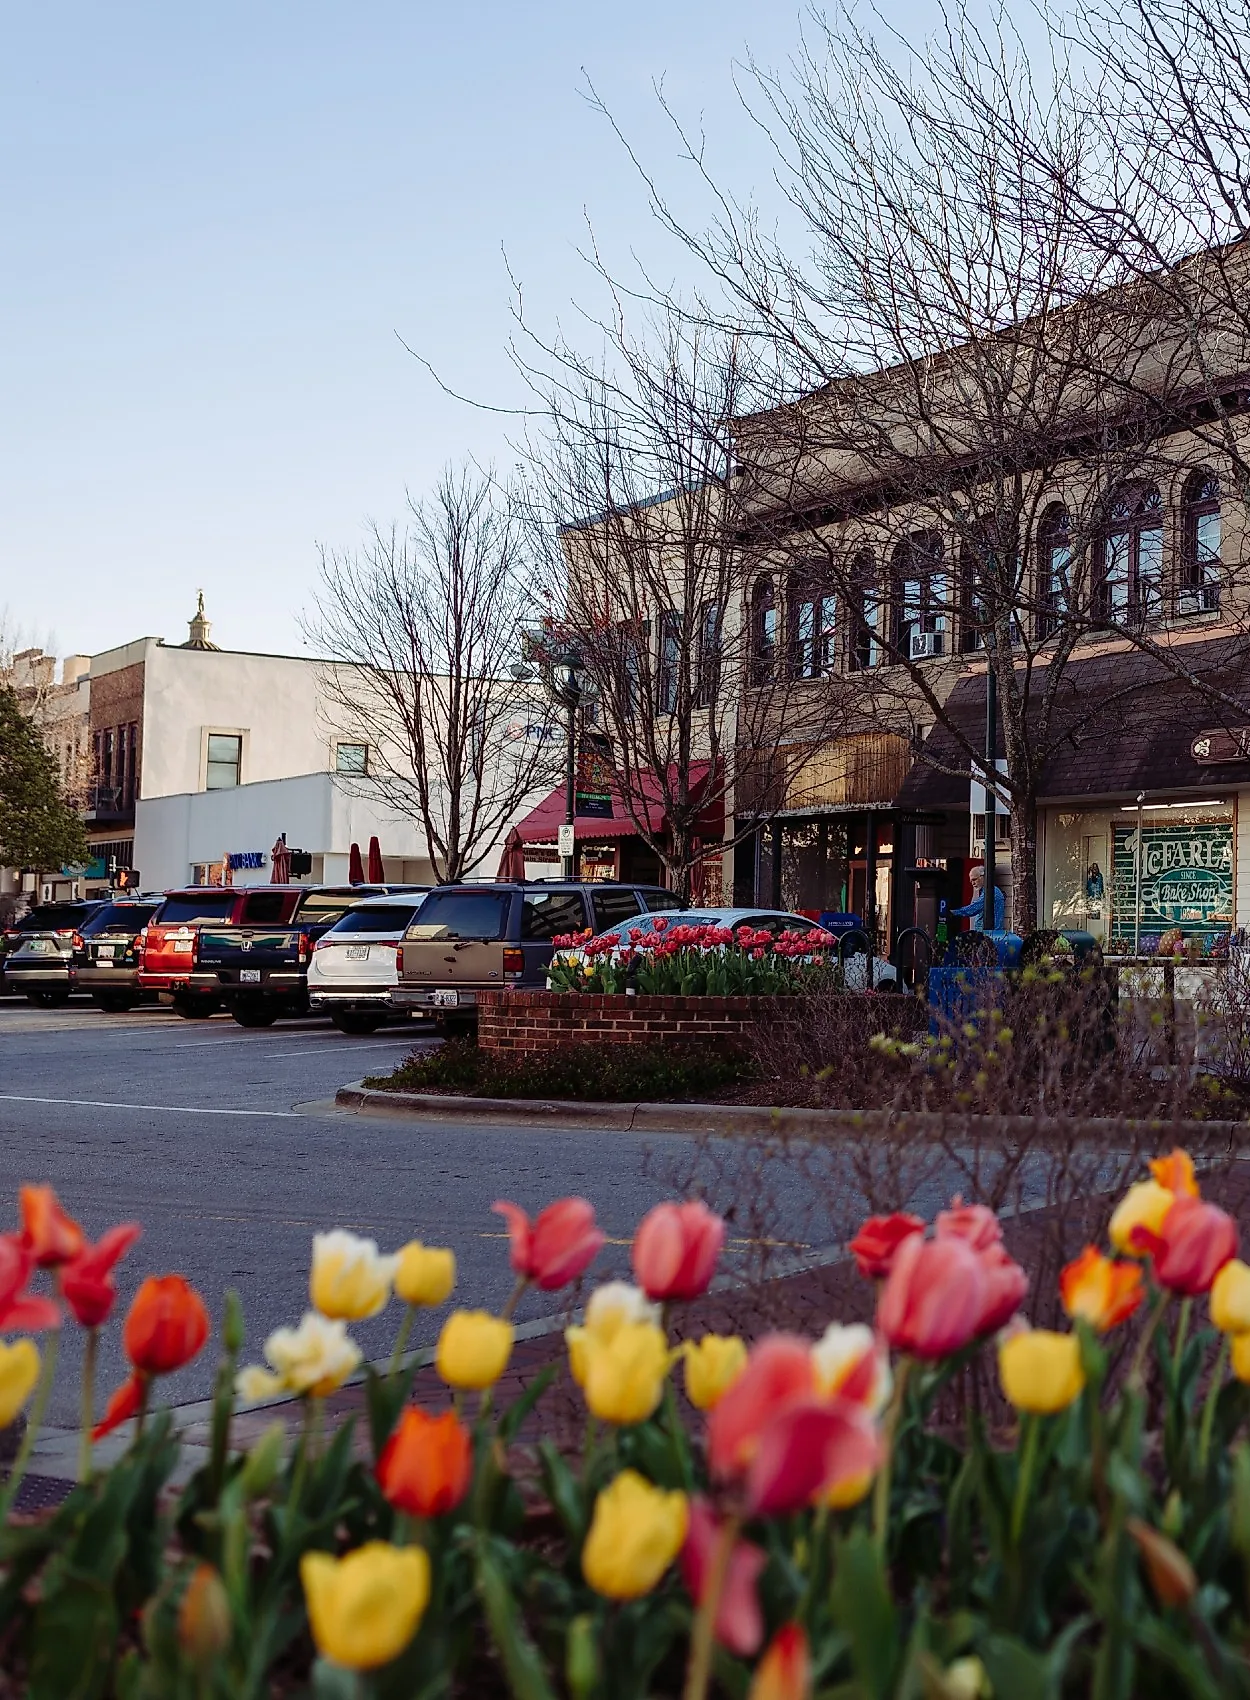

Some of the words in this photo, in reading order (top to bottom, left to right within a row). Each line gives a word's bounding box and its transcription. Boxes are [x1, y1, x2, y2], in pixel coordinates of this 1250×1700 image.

[1126, 834, 1233, 887] McFARLA
[1180, 871, 1197, 880] SINCE
[1161, 884, 1187, 901] Bake
[1187, 882, 1216, 902] Shop
[939, 899, 946, 913] P
